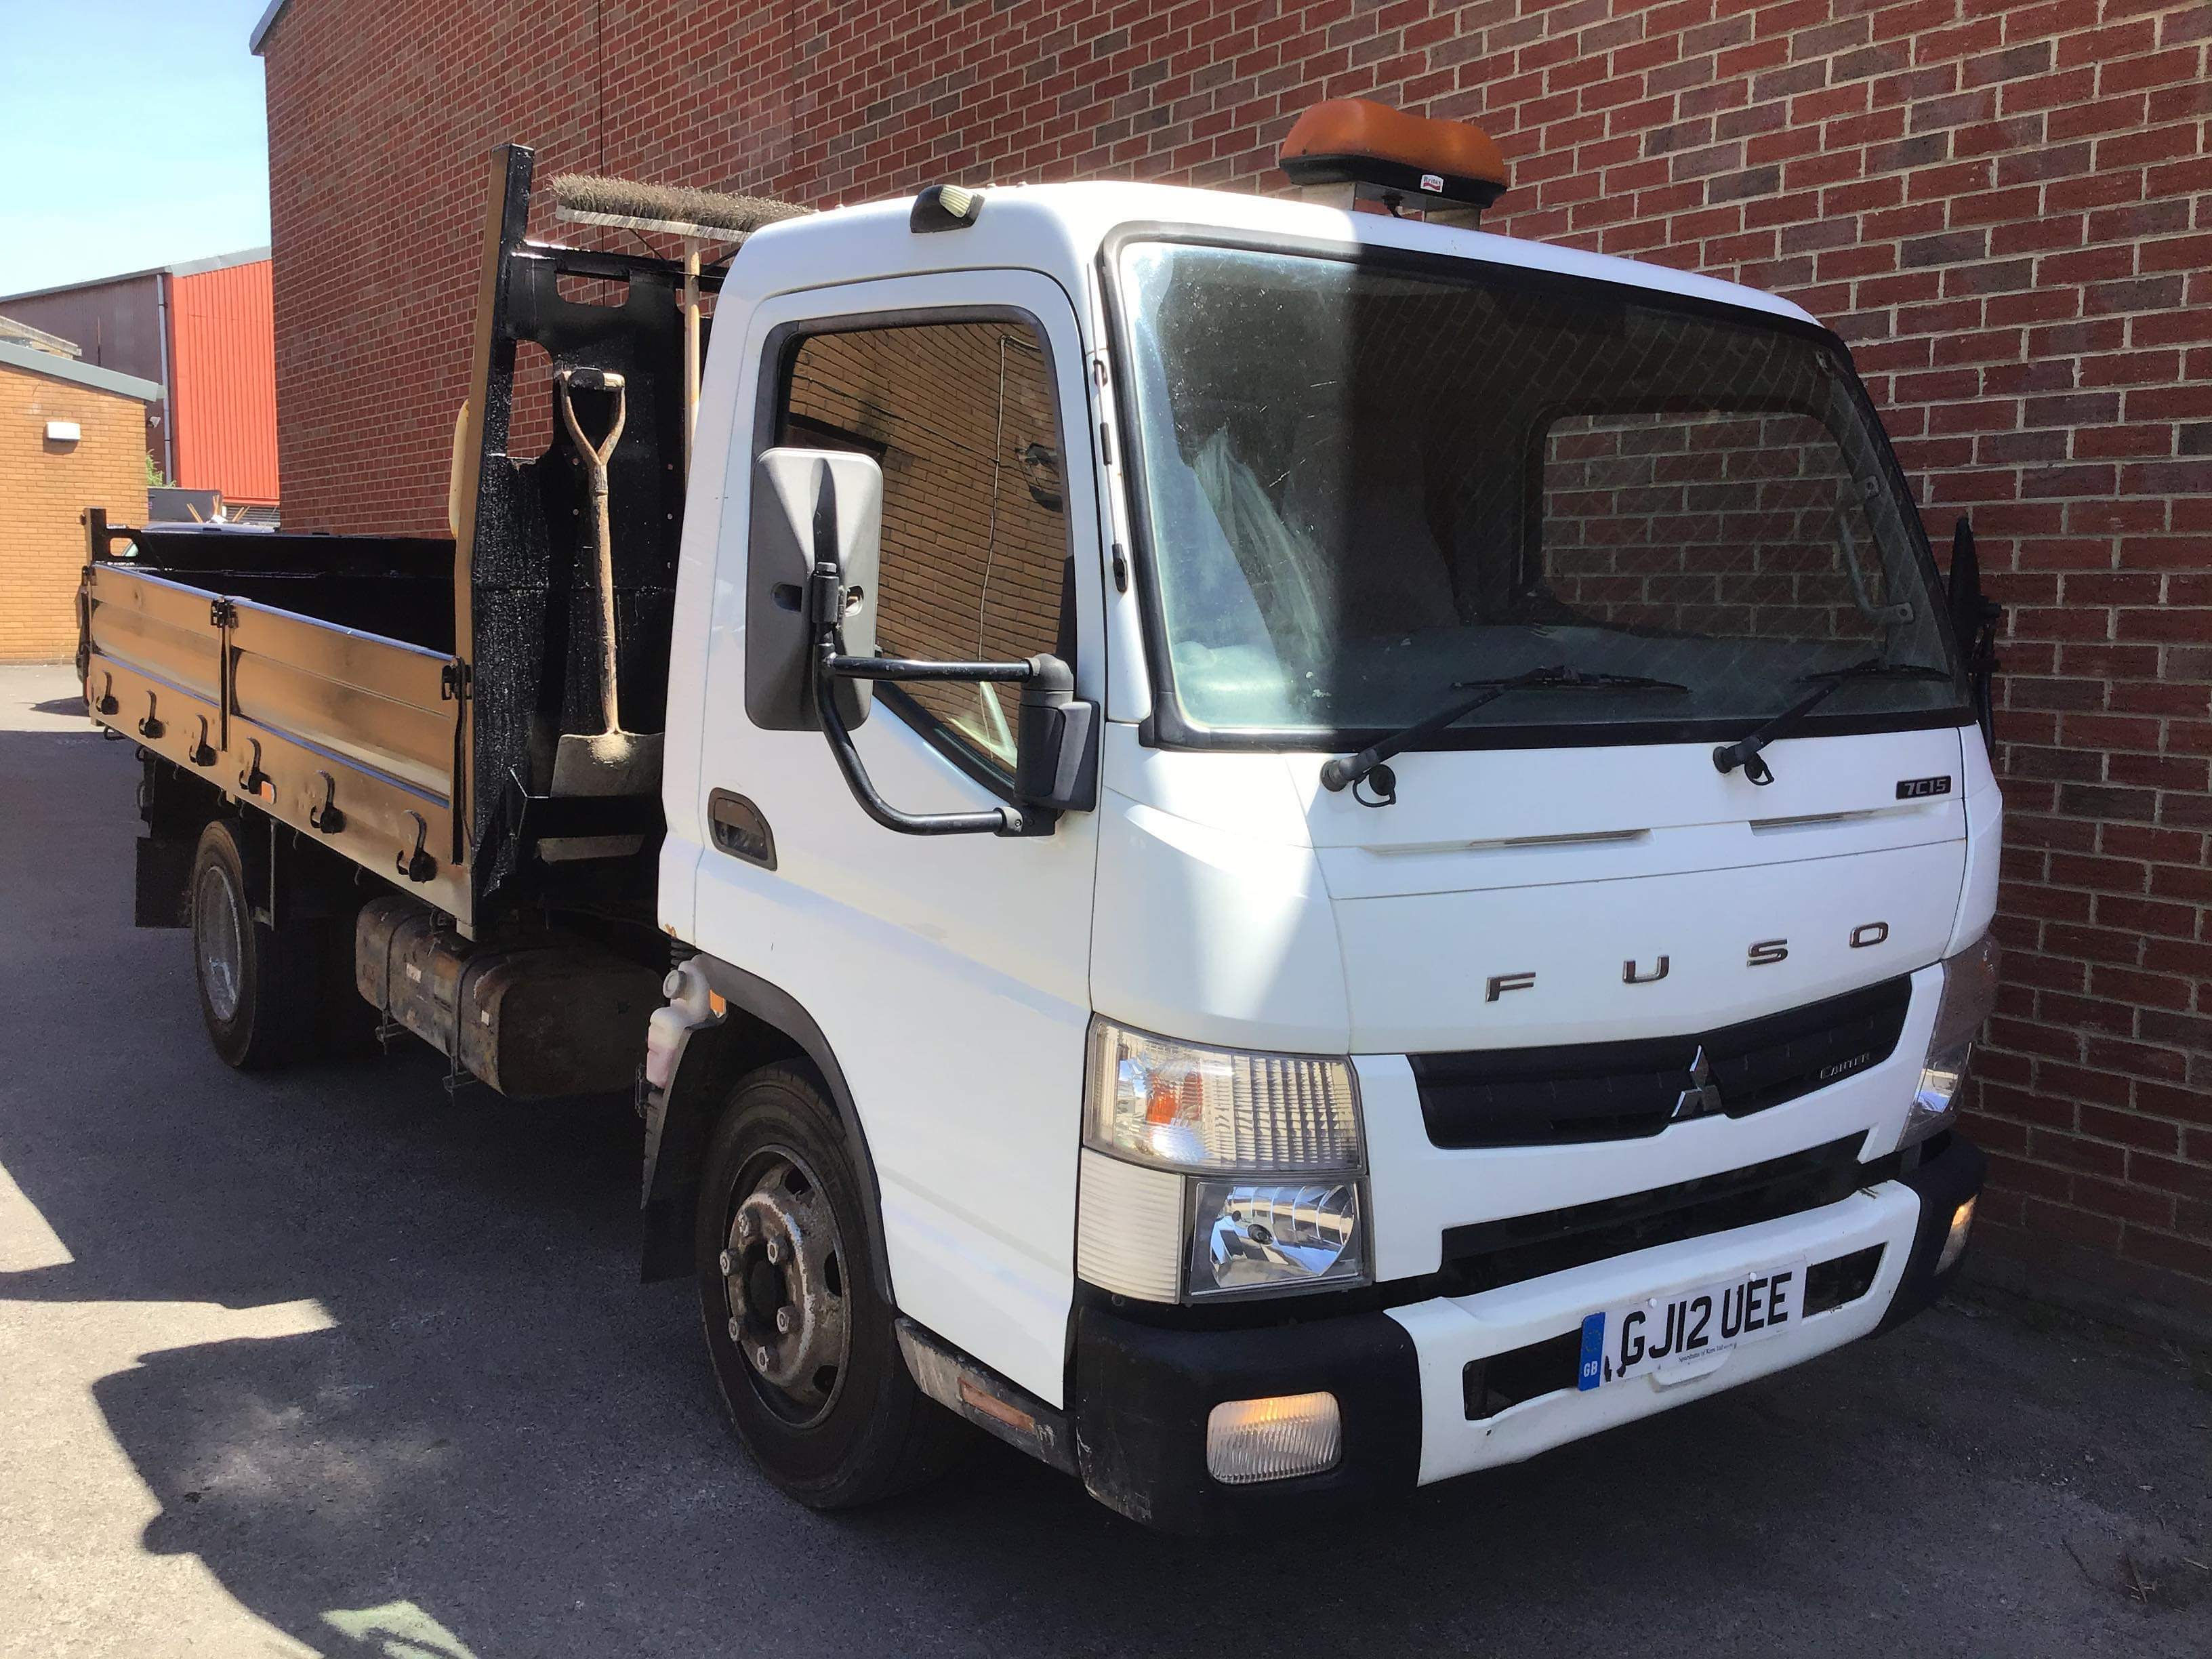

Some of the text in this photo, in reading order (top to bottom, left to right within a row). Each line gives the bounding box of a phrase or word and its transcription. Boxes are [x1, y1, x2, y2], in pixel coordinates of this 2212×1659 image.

[1904, 778, 1946, 795] 7C15
[1486, 922, 1889, 1002] FUSO
[1620, 1271, 1793, 1366] GJ12 UEE
[1584, 1361, 1598, 1377] GB
